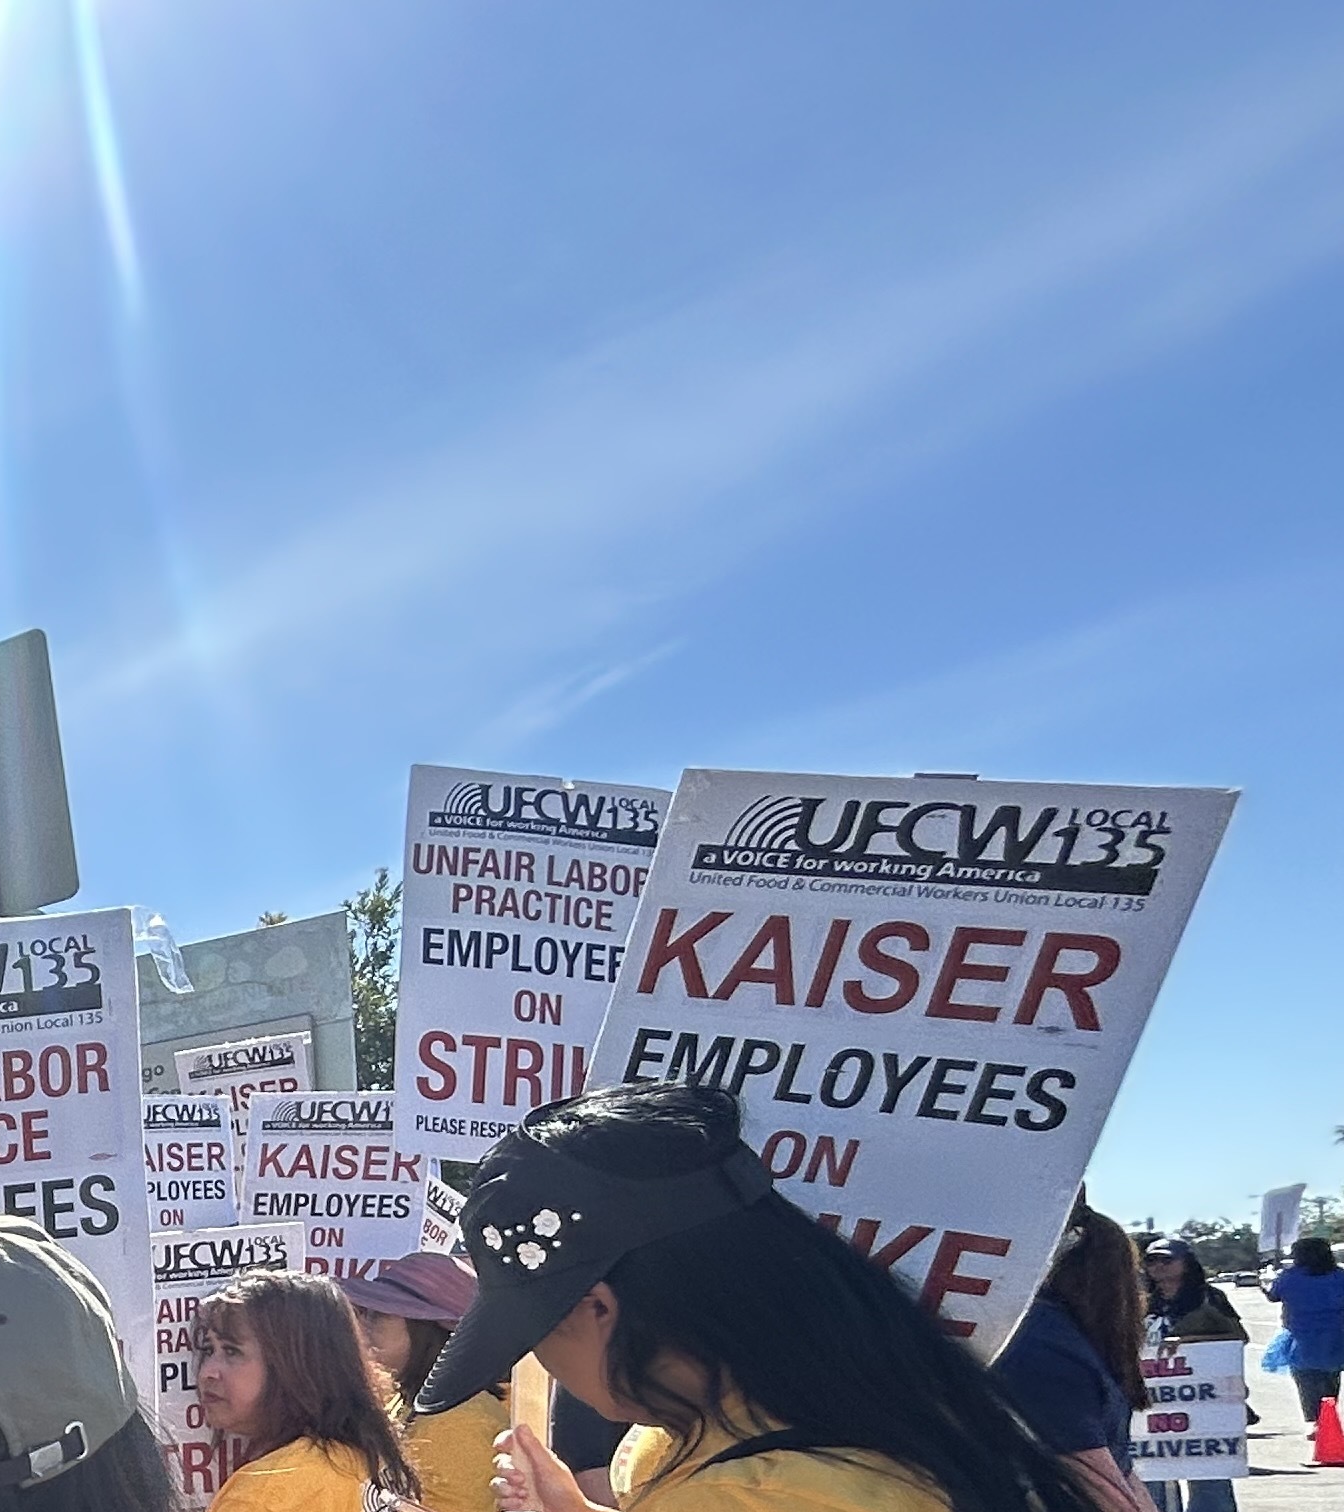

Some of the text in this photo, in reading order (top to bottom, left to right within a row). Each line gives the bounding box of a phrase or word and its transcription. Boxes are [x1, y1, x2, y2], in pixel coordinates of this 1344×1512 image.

[479, 784, 657, 829] UFCW LOCAL
[607, 805, 659, 832] 135
[444, 815, 608, 840] VOICE for working America
[797, 797, 1173, 868] UFCW LOCAL
[1050, 825, 1173, 870] 135
[414, 843, 536, 884] UNFAIR
[703, 849, 1042, 883] a VOICE for working America
[688, 870, 1146, 912] United Food & Commercial Workers Union Local 135
[451, 883, 614, 933] PRACTICE
[17, 934, 95, 958] LOCAL
[422, 927, 627, 984] EMPLOYEE
[11, 950, 102, 994] 135
[637, 908, 1122, 1032] KAISER
[36, 1013, 75, 1031] Local
[77, 1010, 104, 1027] 135
[513, 989, 563, 1026] ON
[416, 1030, 592, 1108] STRI
[623, 1028, 1077, 1132] EMPLOYEES
[295, 1099, 386, 1123] UFCW
[416, 1114, 518, 1139] PLEASE RESP
[258, 1143, 422, 1184] KAISER
[761, 1130, 860, 1187] ON
[146, 1179, 226, 1202] PLOYEES
[160, 1208, 184, 1227] ON
[253, 1192, 411, 1219] EMPLOYEES
[248, 1234, 287, 1246] LOCAL
[310, 1227, 344, 1248] ON
[423, 1218, 449, 1247] BOR
[245, 1244, 288, 1264] 135
[156, 1296, 200, 1325] AIR
[1147, 1411, 1190, 1434] NO
[1128, 1437, 1241, 1459] ELIVERY
